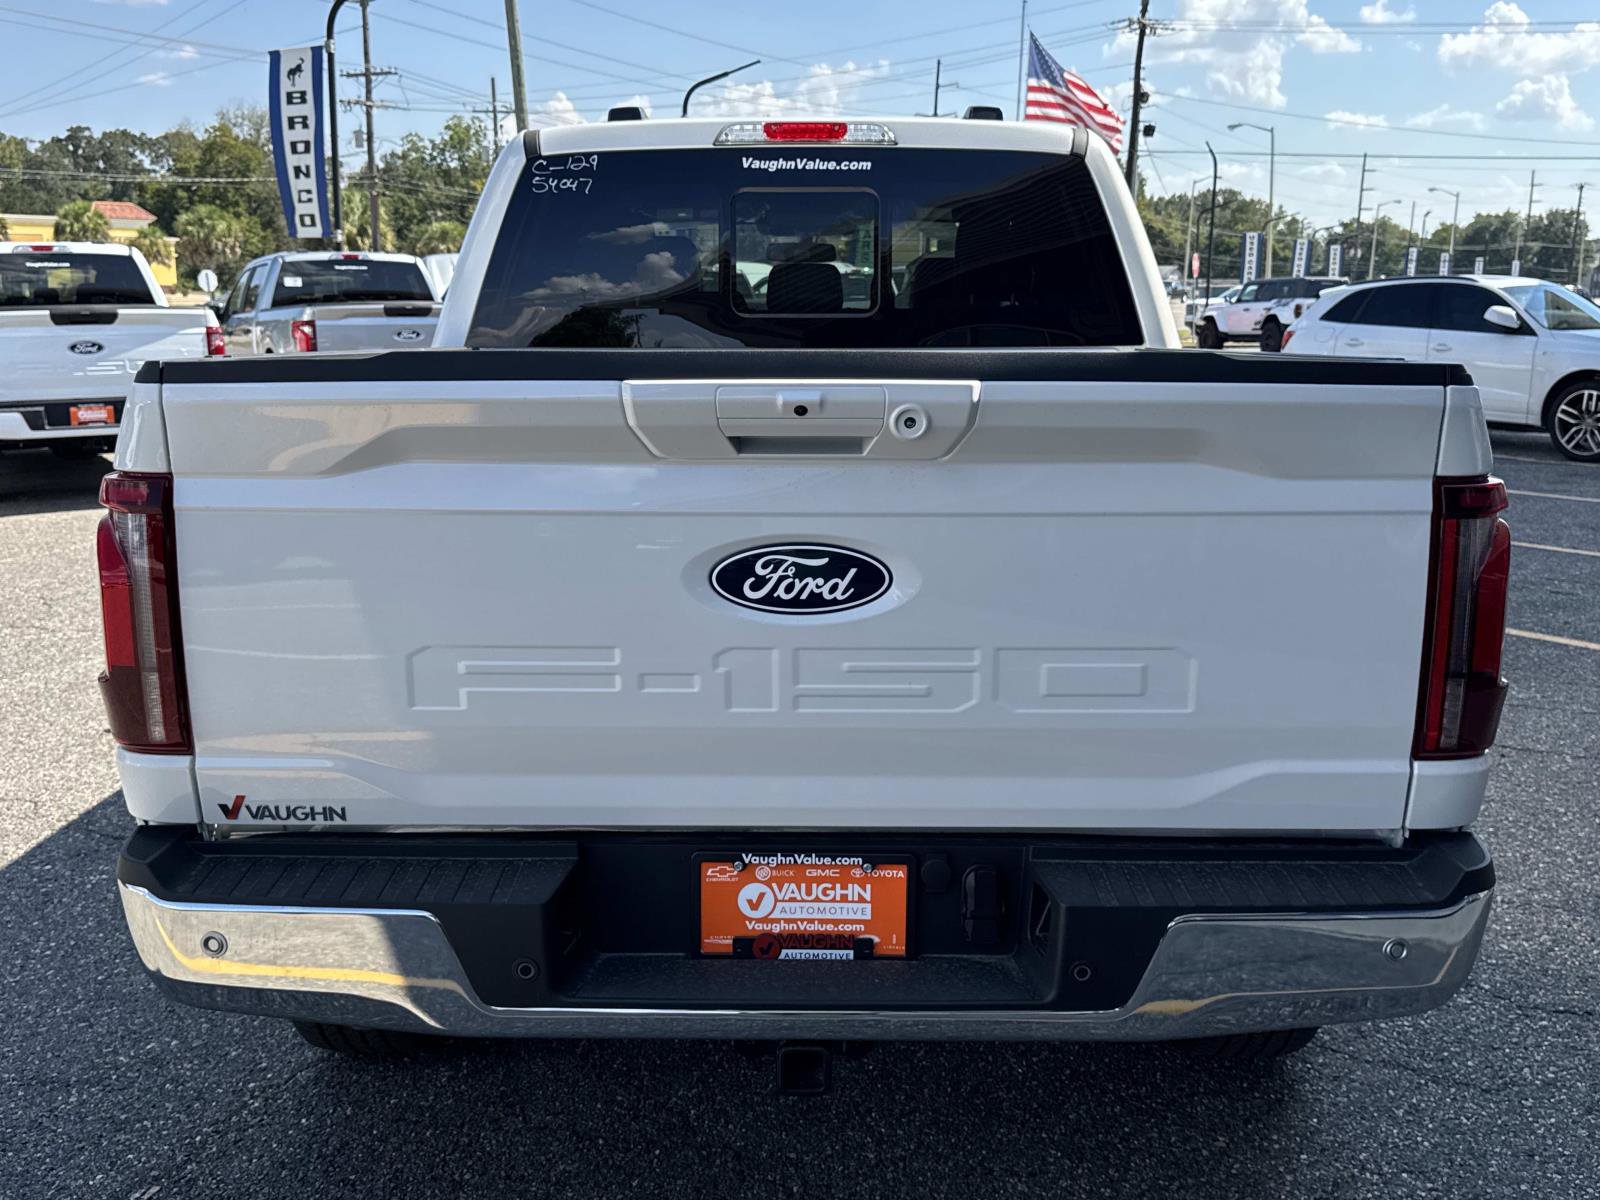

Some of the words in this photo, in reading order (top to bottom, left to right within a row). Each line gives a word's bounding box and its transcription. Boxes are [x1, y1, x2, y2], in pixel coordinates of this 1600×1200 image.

[286, 90, 317, 228] BRONCO
[531, 154, 598, 174] C-129
[741, 157, 872, 172] VaughnValue.com
[532, 176, 593, 195] 54047
[742, 554, 854, 604] Ford
[405, 645, 1198, 715] F-150
[244, 804, 347, 822] VAUGHN
[741, 852, 863, 867] VaughnValue.com
[771, 869, 795, 877] BUICK
[805, 869, 840, 877] GMC
[772, 882, 872, 902] VAUGHN
[779, 906, 868, 916] AUTOMOTIVE
[745, 920, 865, 933] VaughnValue.com
[784, 952, 852, 960] AUTOMOTIVE
